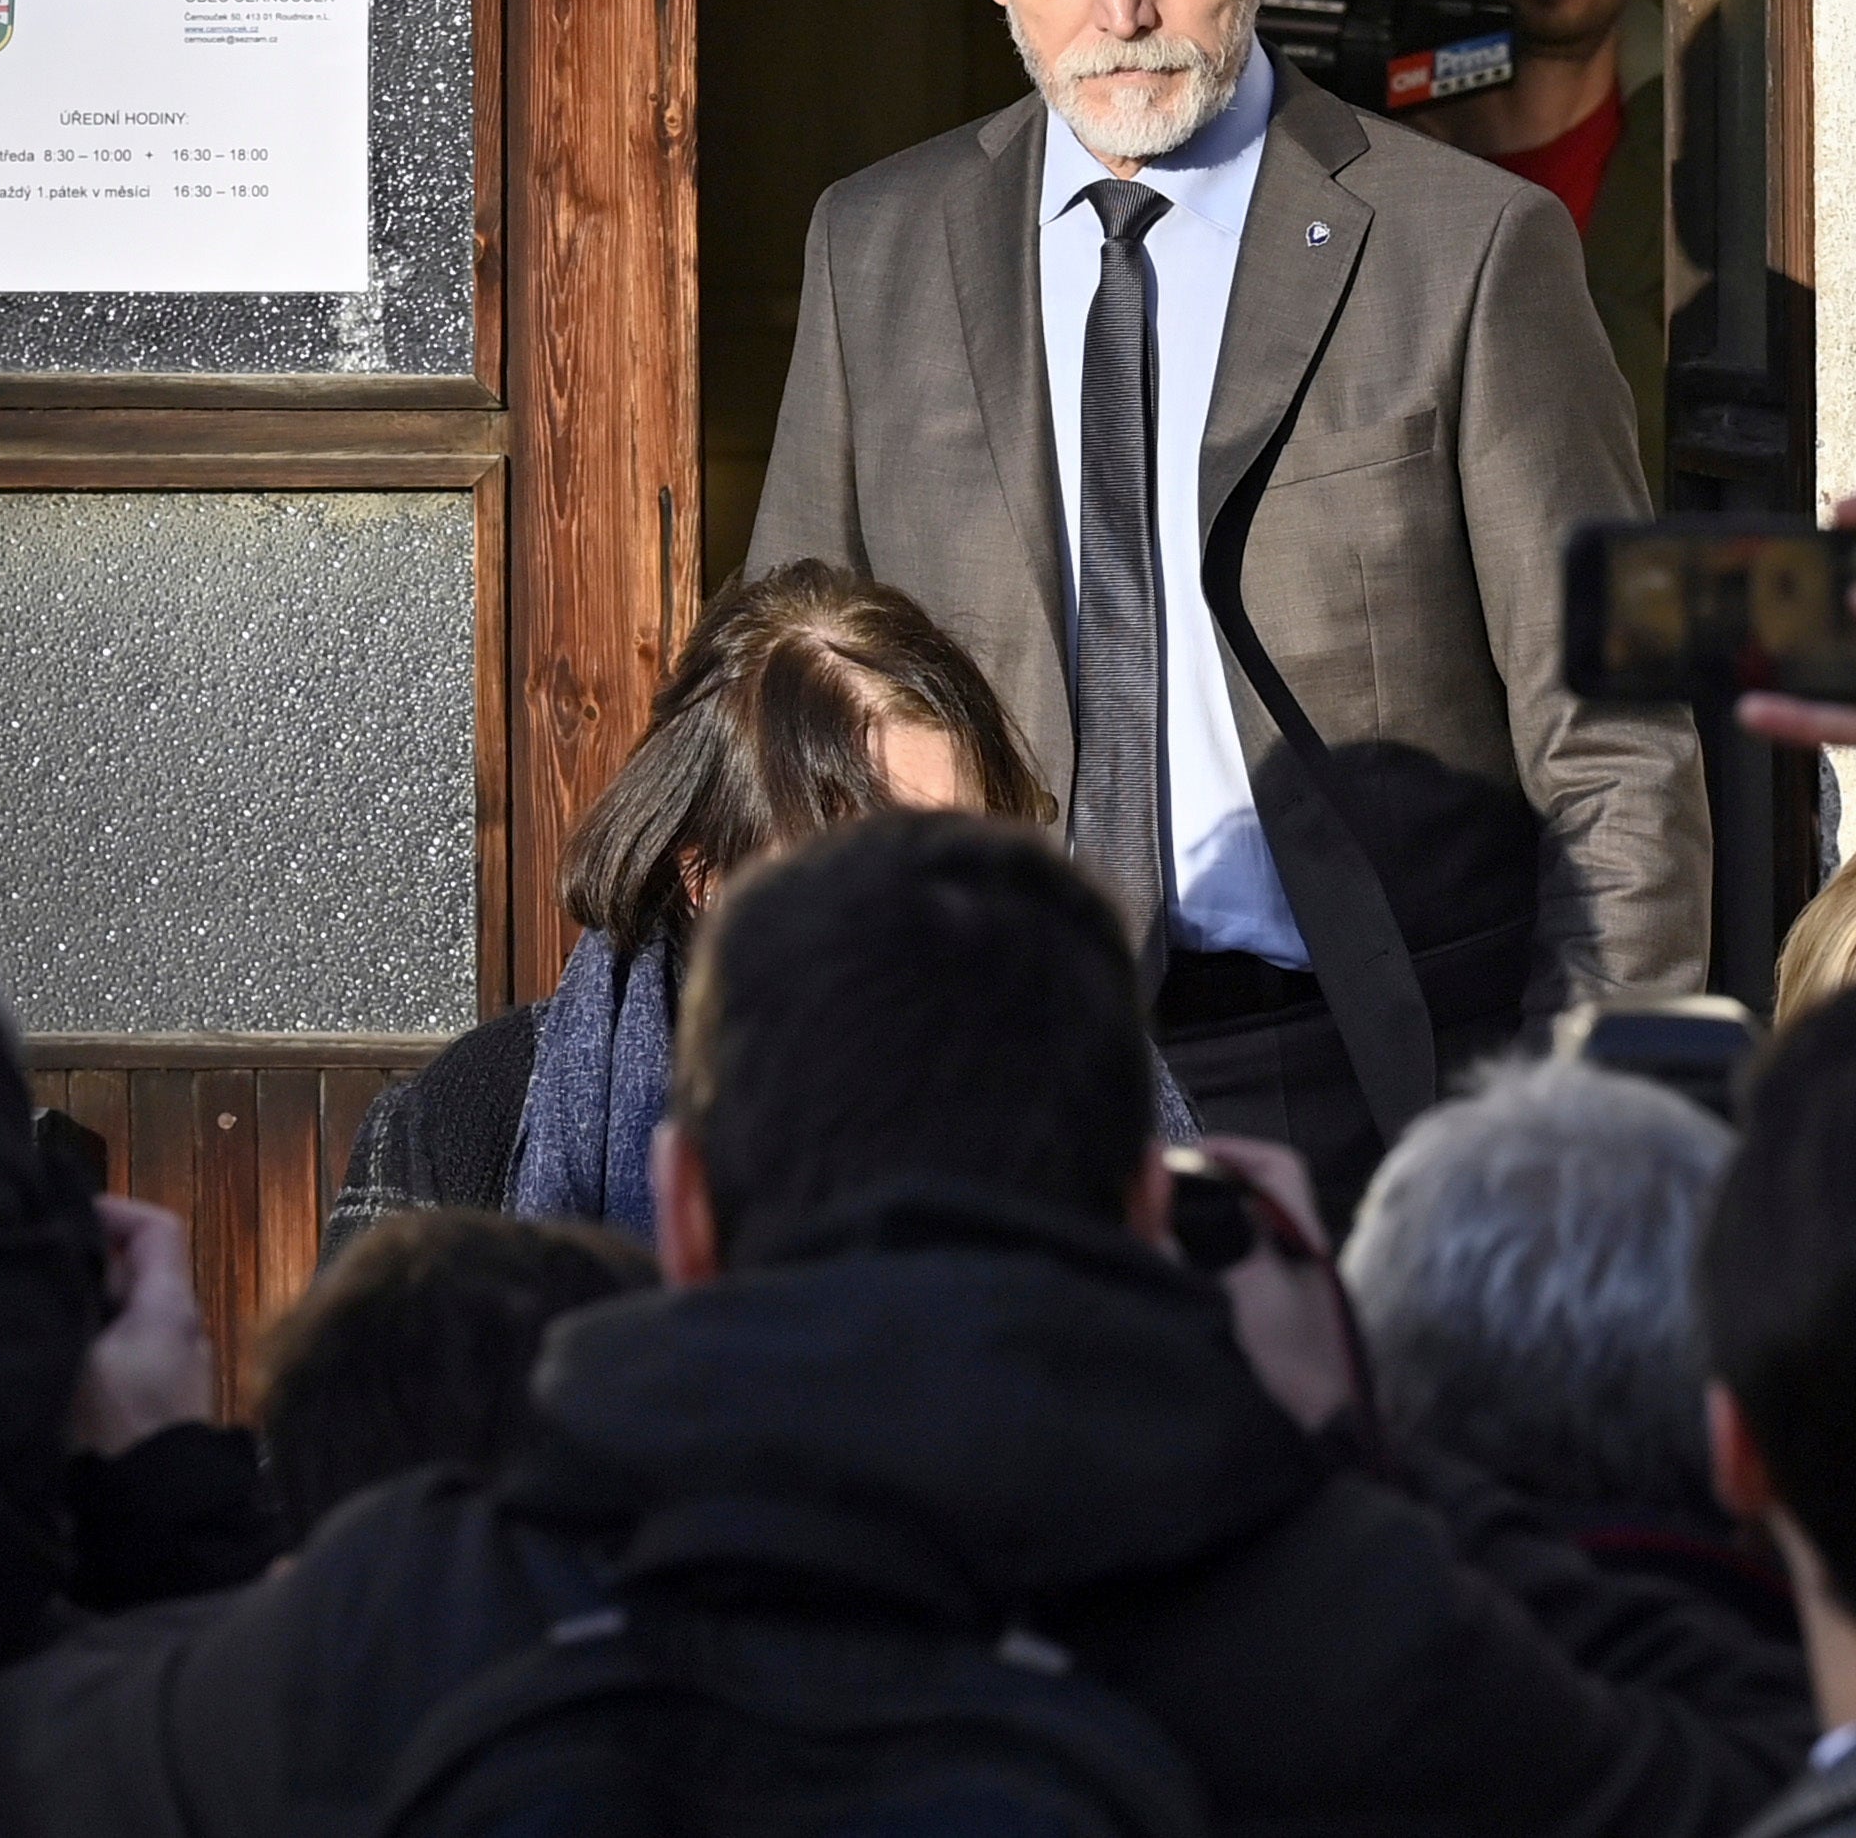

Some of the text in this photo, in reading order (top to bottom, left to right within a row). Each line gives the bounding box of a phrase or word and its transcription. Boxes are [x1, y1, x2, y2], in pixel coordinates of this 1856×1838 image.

[59, 109, 190, 126] ÚŘEDNÍ HODINY:
[43, 149, 75, 163] 8:30
[93, 148, 132, 163] 10:00
[92, 189, 100, 199] v
[104, 184, 151, 199] měsíci
